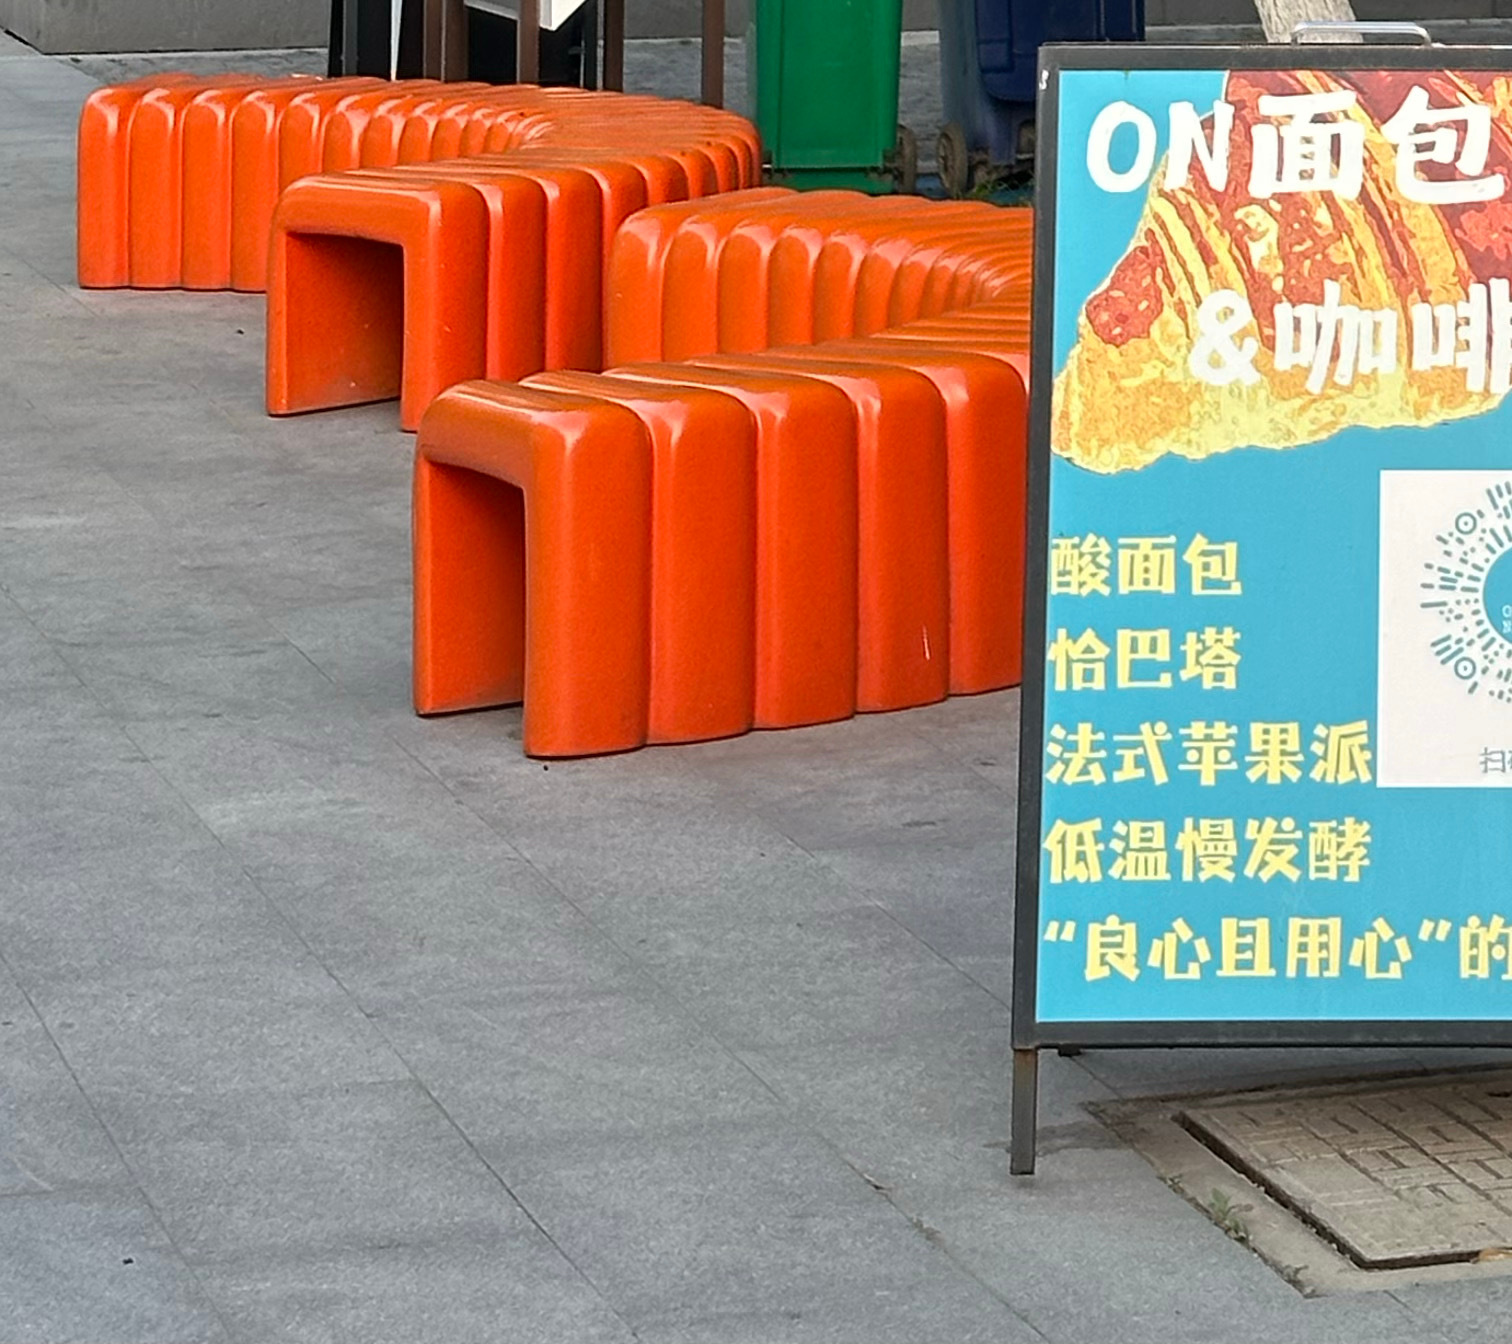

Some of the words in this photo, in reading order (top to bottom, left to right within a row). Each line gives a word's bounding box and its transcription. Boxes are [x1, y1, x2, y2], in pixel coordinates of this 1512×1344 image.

[1050, 534, 1242, 597] 酸面包
[1047, 626, 1242, 691] 恰巴塔
[1044, 720, 1373, 786] 法式苹果派
[1044, 817, 1372, 883] 低温慢发酵
